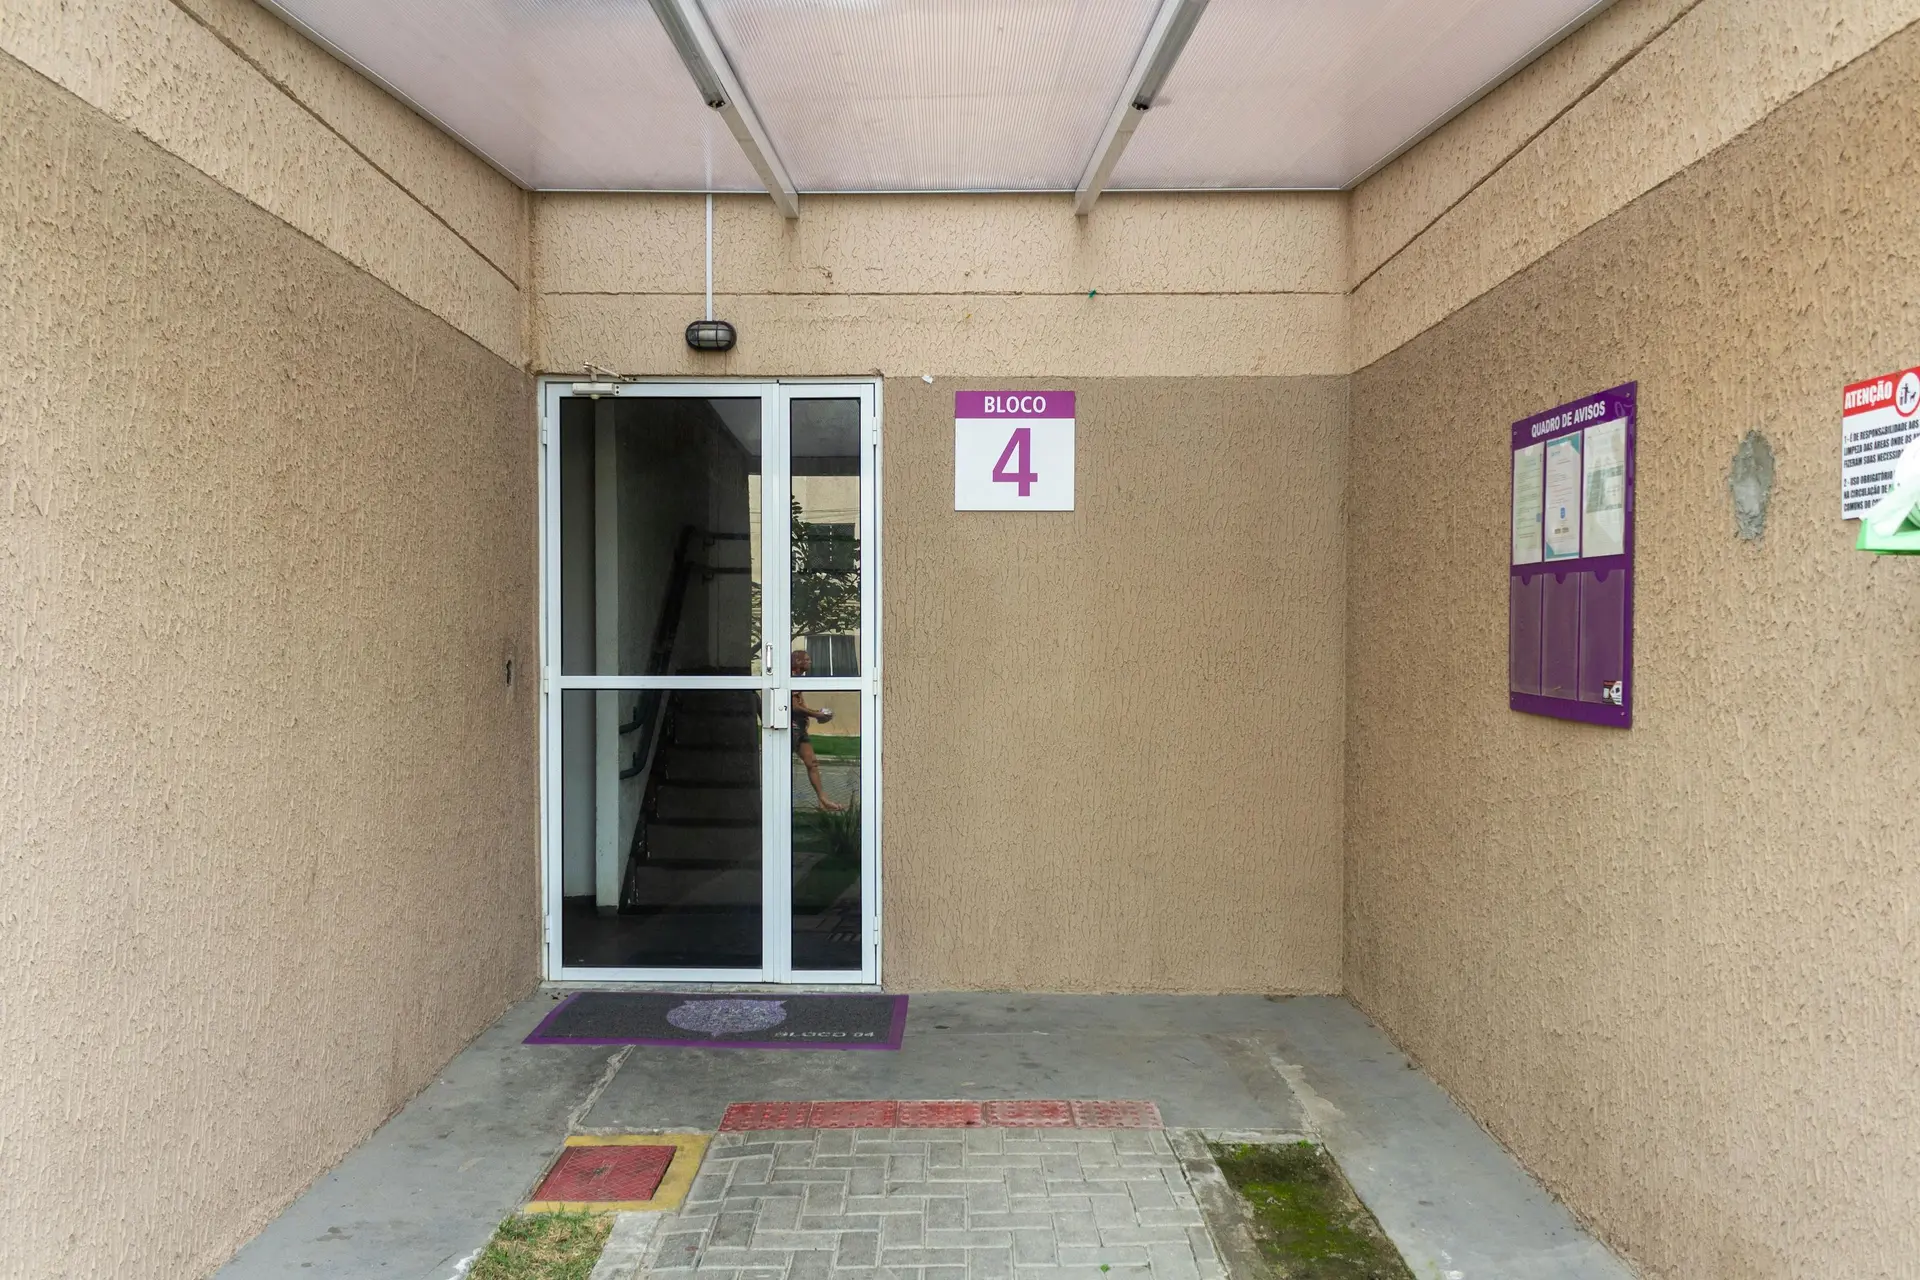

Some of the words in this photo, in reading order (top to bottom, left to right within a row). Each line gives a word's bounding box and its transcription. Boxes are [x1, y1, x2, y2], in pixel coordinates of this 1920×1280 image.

[984, 396, 1047, 414] BLOCO
[1844, 380, 1893, 410] ATENÇÃO
[1531, 415, 1560, 438] QUADRO
[1561, 411, 1573, 428] DE
[1573, 400, 1606, 425] AVISOS
[1853, 432, 1860, 441] DE
[992, 427, 1038, 497] 4
